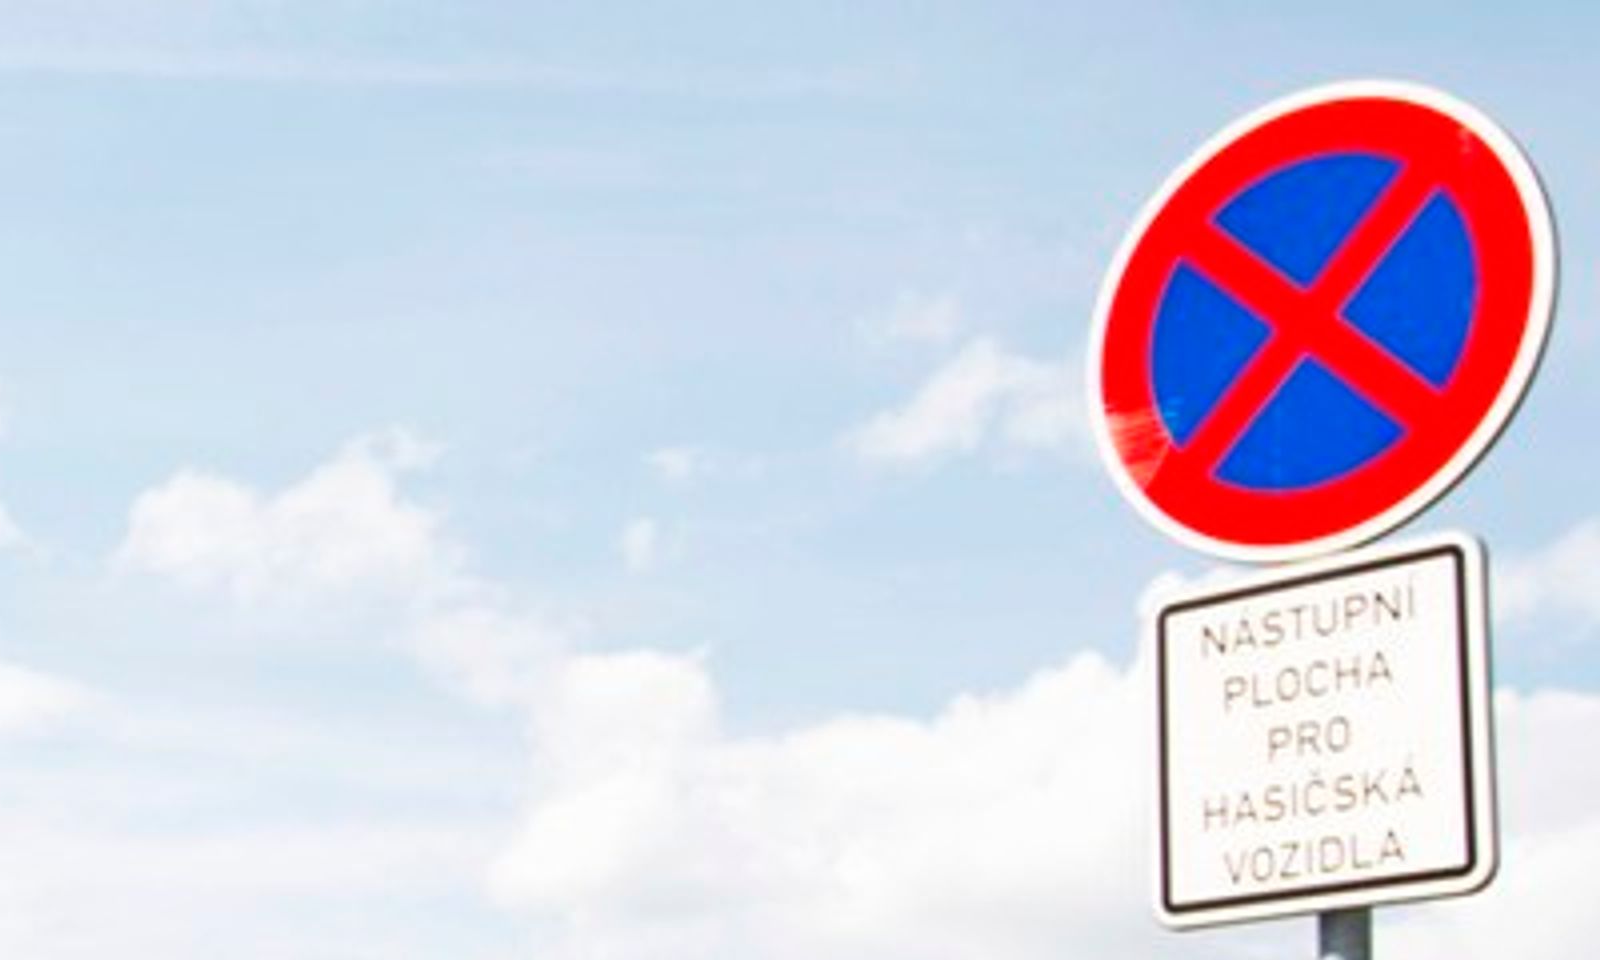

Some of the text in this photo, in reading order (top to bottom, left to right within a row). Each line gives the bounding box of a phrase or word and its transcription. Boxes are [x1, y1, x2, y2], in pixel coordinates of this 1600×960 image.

[1201, 577, 1417, 657] NÁSTUPNÍ
[1223, 650, 1394, 712] PLOCHA
[1267, 715, 1352, 763] PRO
[1203, 754, 1424, 832] HASIČSKÁ
[1222, 829, 1406, 885] VOZIDLA
